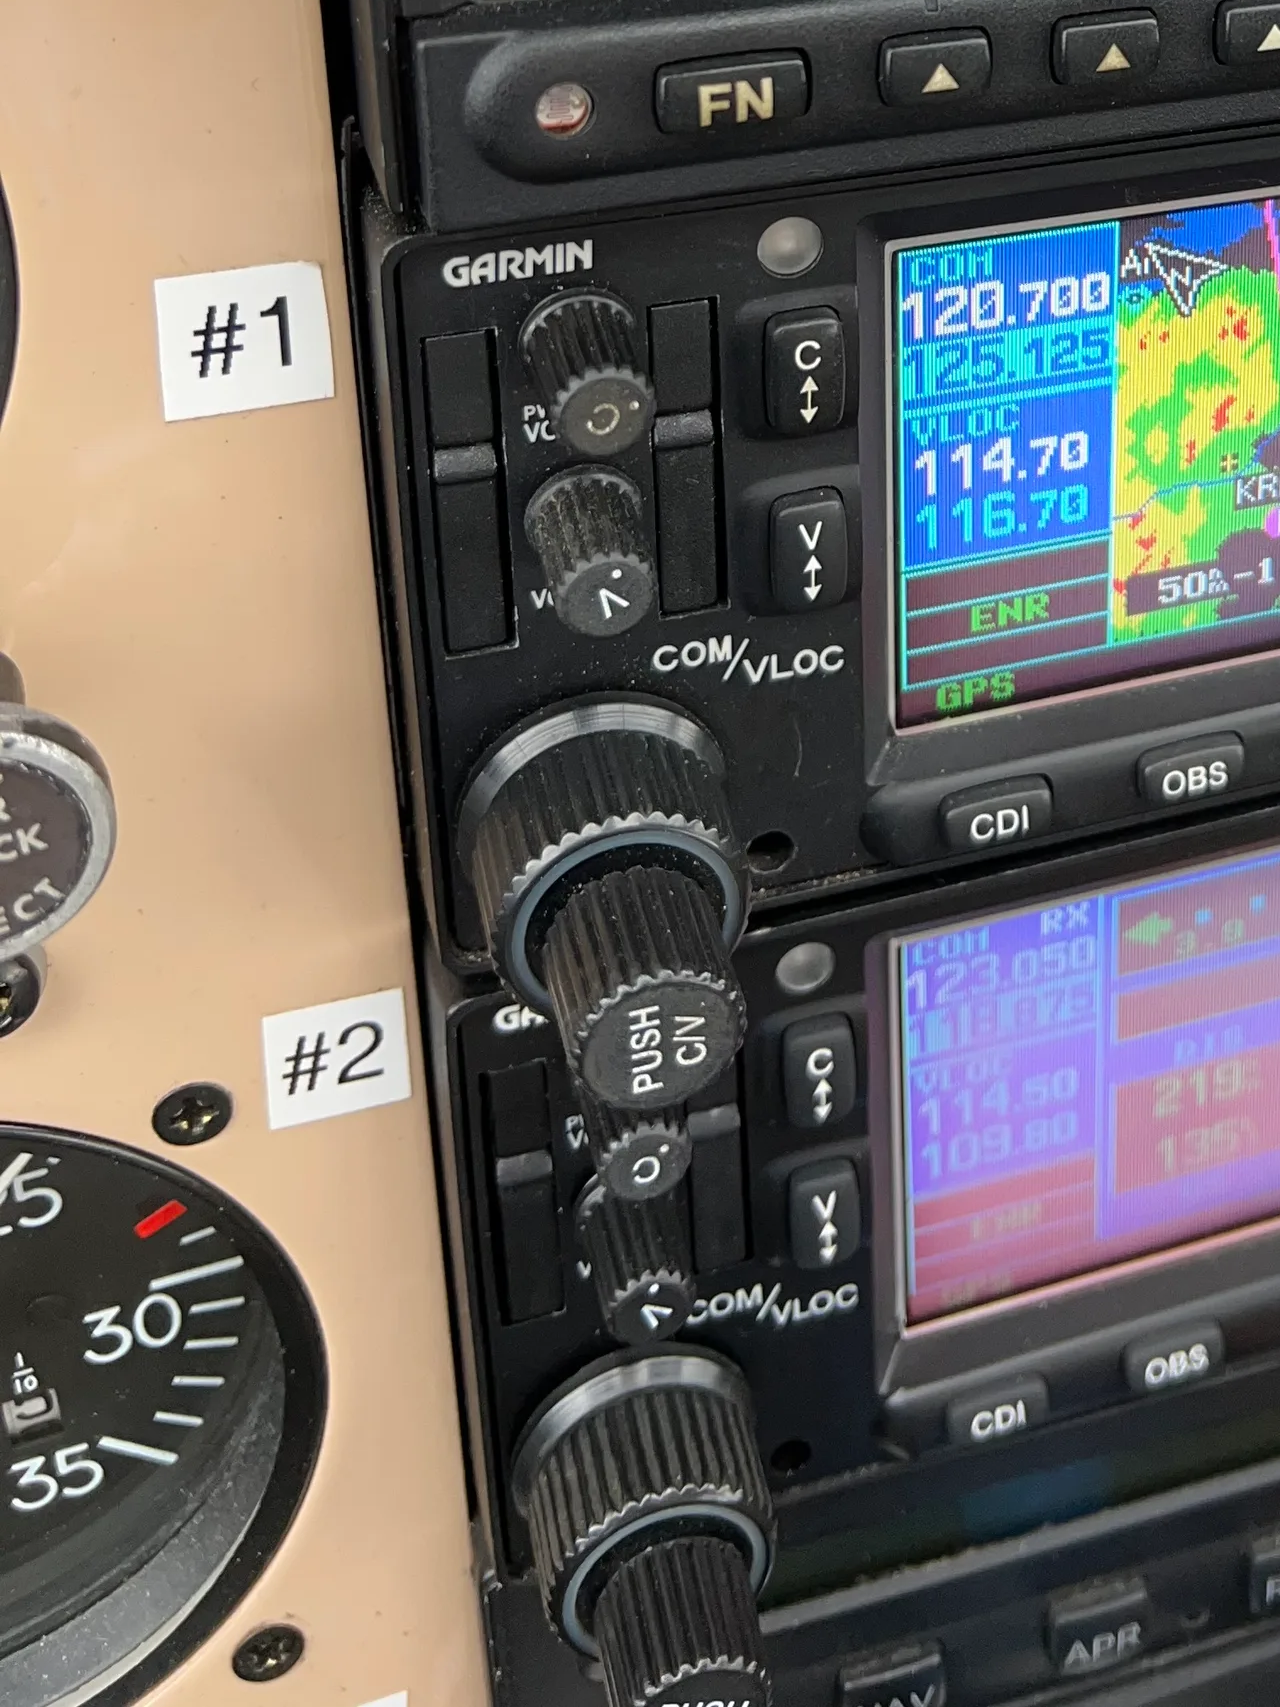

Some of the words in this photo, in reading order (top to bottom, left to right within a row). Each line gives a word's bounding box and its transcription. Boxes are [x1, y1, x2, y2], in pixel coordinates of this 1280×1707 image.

[698, 77, 774, 127] FN
[442, 238, 595, 290] GARMIN
[909, 253, 995, 287] COM
[902, 270, 1111, 342] 120.700
[191, 295, 295, 379] #1
[795, 340, 822, 371] C
[911, 404, 1021, 446] VLOC
[915, 431, 1090, 496] 114.70
[799, 521, 824, 553] V
[915, 484, 1089, 552] 116.70
[970, 592, 1050, 634] ENR
[653, 634, 846, 686] COM/VLOC
[935, 672, 1015, 714] GPS
[1162, 761, 1229, 799] OBS
[970, 808, 1030, 842] CDI
[1040, 901, 1091, 936] RX
[282, 1021, 385, 1096] #2
[629, 1005, 665, 1095] PUSH
[83, 1292, 183, 1365] 30
[1144, 1342, 1211, 1390] OBS
[969, 1399, 1028, 1440] CDI
[9, 1442, 105, 1513] 35
[1063, 1618, 1143, 1672] APR
